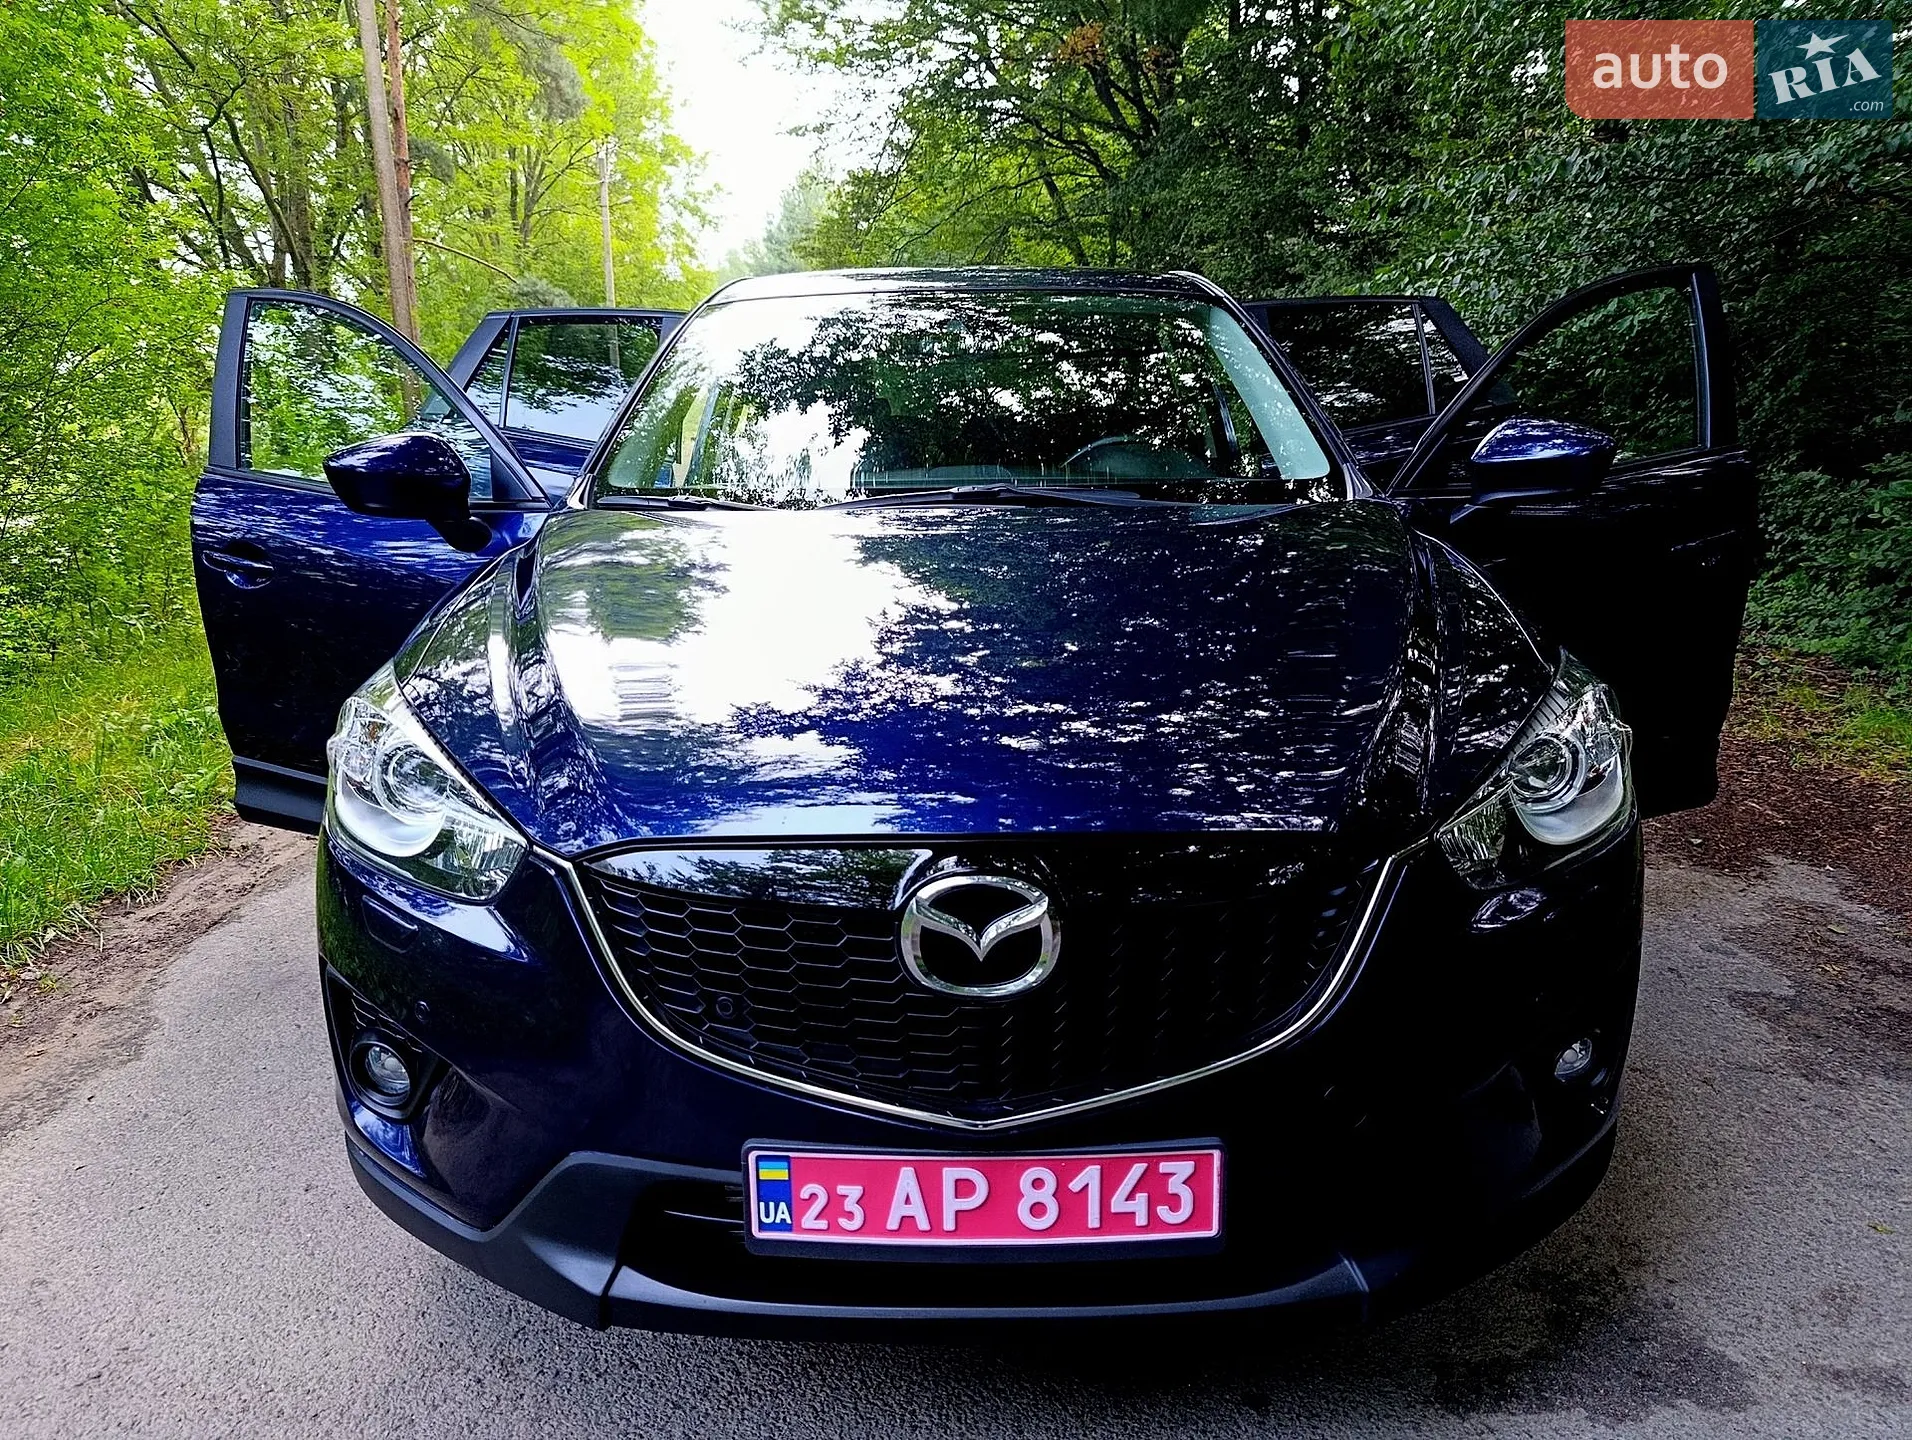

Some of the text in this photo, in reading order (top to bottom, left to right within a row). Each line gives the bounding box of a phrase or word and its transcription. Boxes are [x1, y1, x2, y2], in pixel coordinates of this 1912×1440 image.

[759, 1201, 792, 1225] UA
[799, 1161, 1195, 1232] 23 AP 8143
